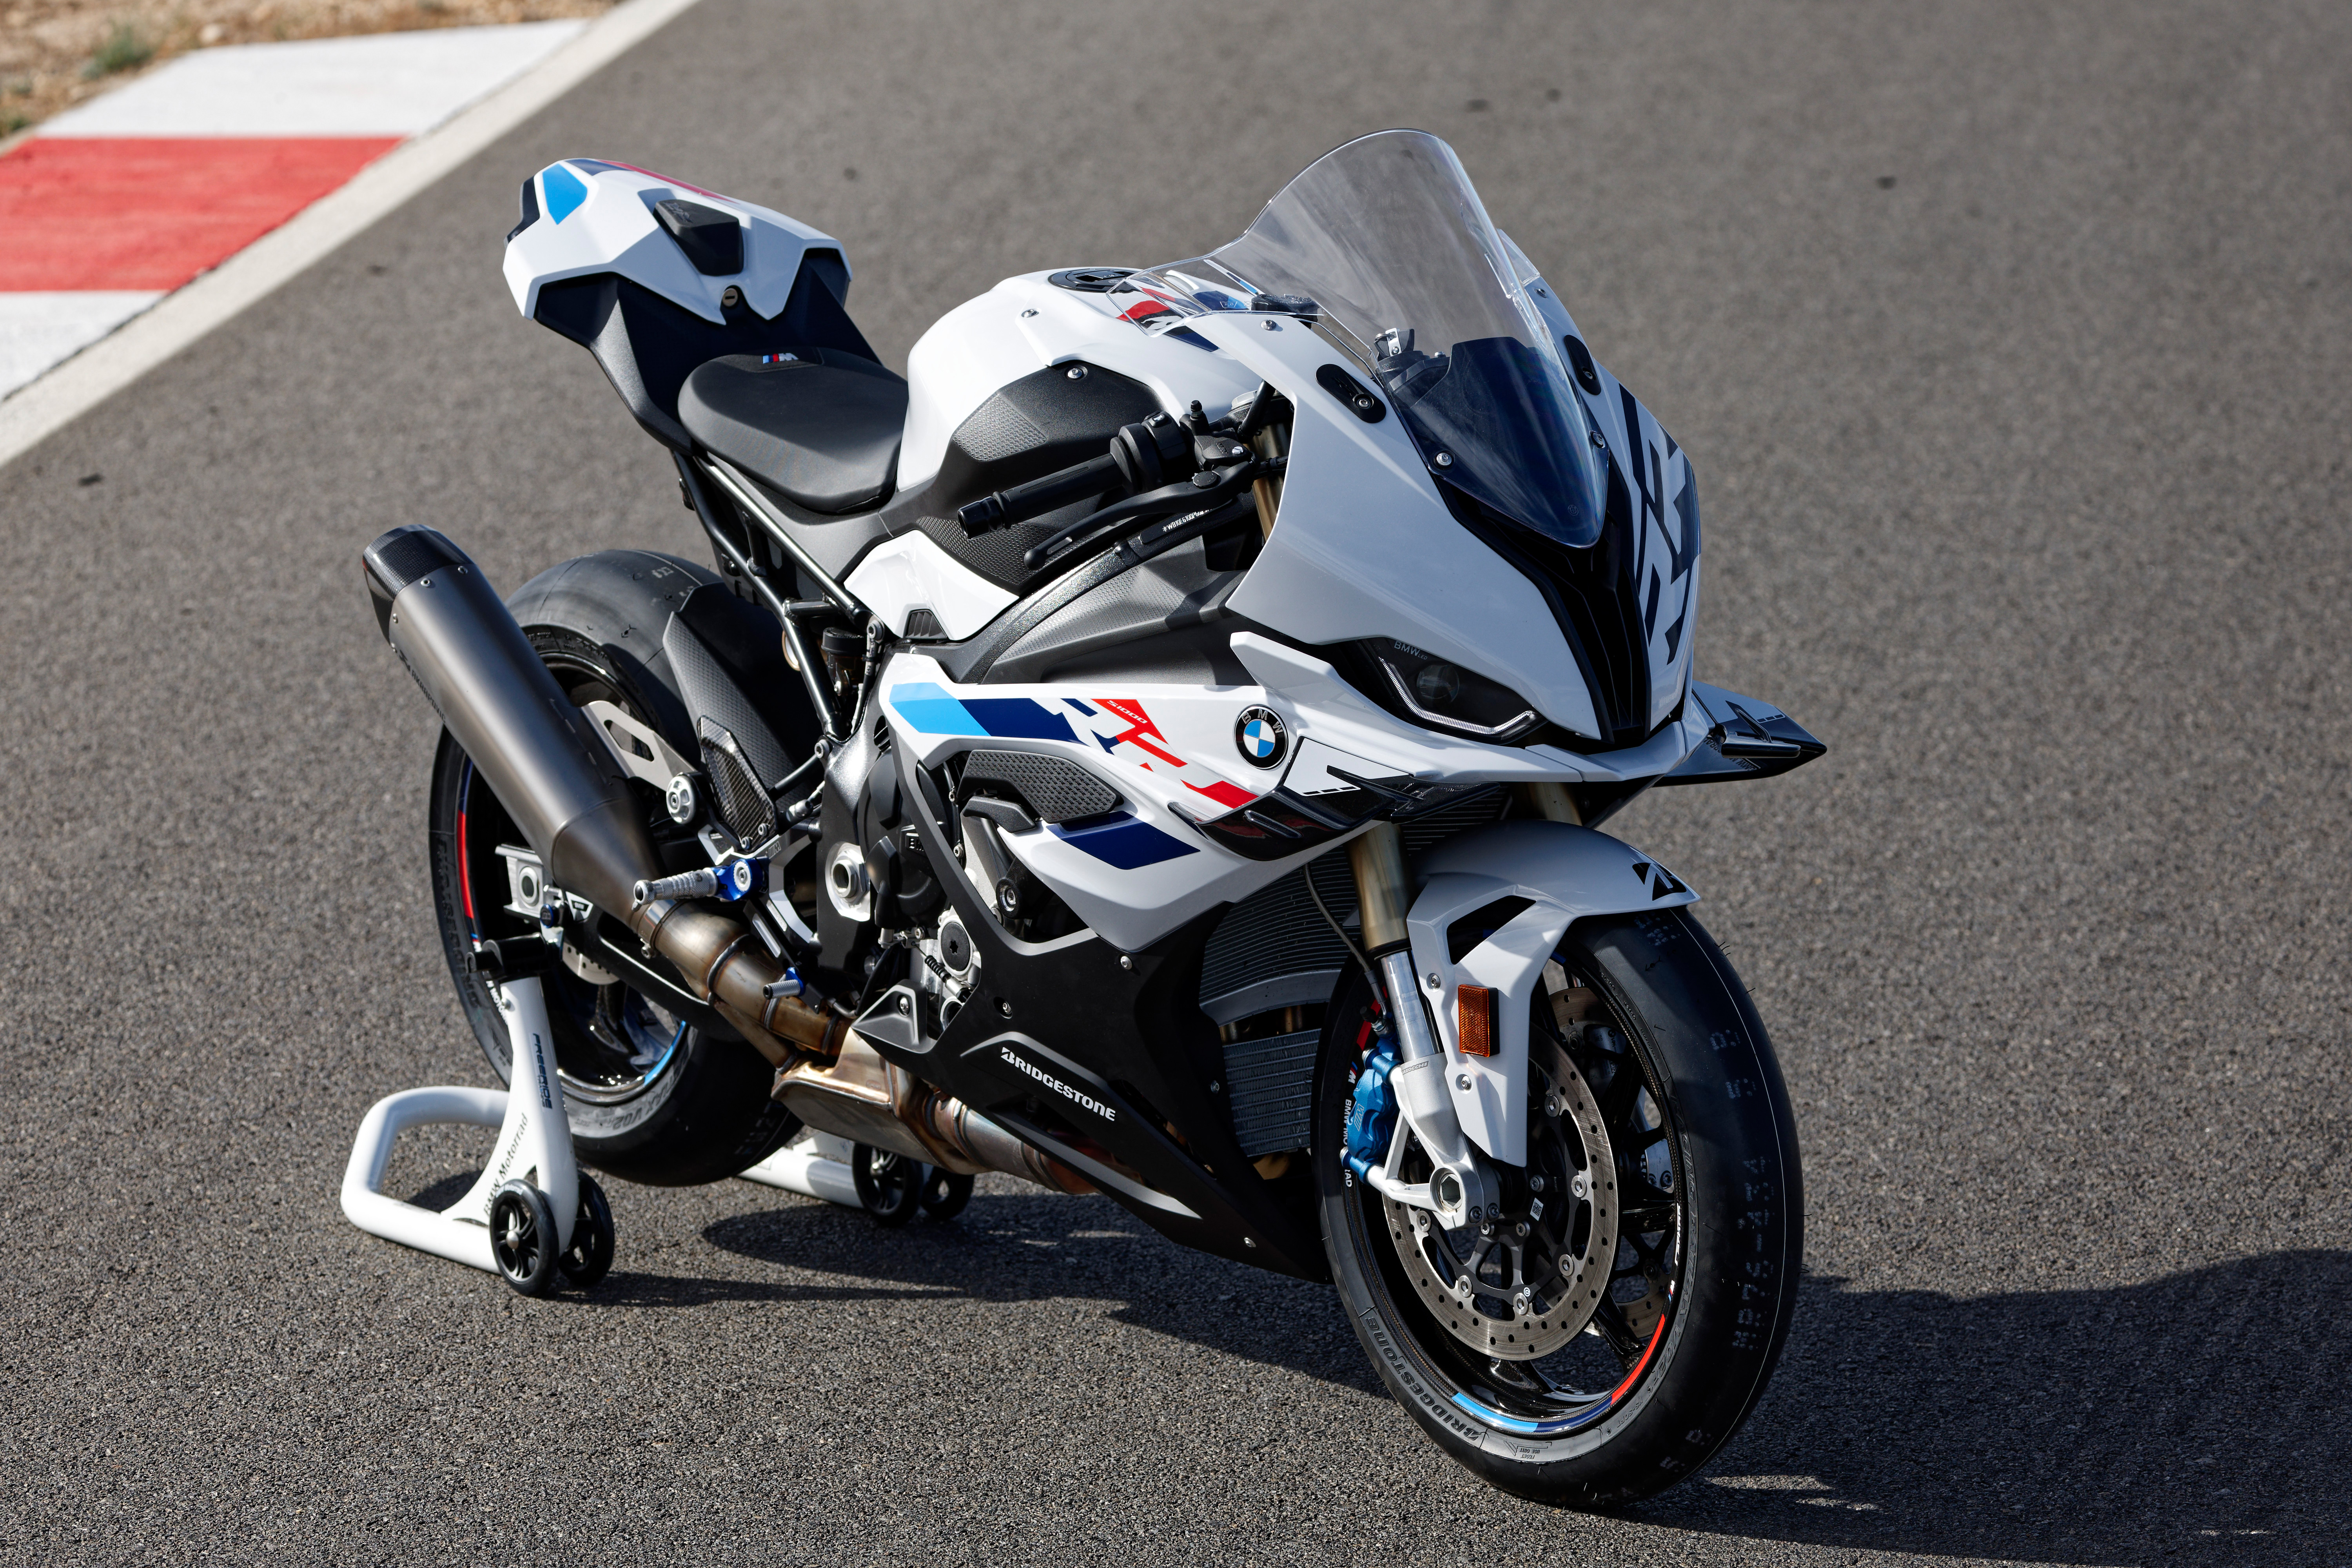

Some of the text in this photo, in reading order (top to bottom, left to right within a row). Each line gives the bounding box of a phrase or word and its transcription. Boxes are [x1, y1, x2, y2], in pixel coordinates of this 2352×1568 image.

[1394, 641, 1421, 657] BMW
[1107, 700, 1148, 724] S1000
[1241, 709, 1283, 734] BMW
[909, 837, 924, 851] BM
[533, 1033, 553, 1109] FREERIDE
[1001, 1047, 1116, 1122] BRIDGESTONE
[499, 1112, 528, 1178] Motorrad
[1365, 1316, 1482, 1441] BRIDGESTONE
